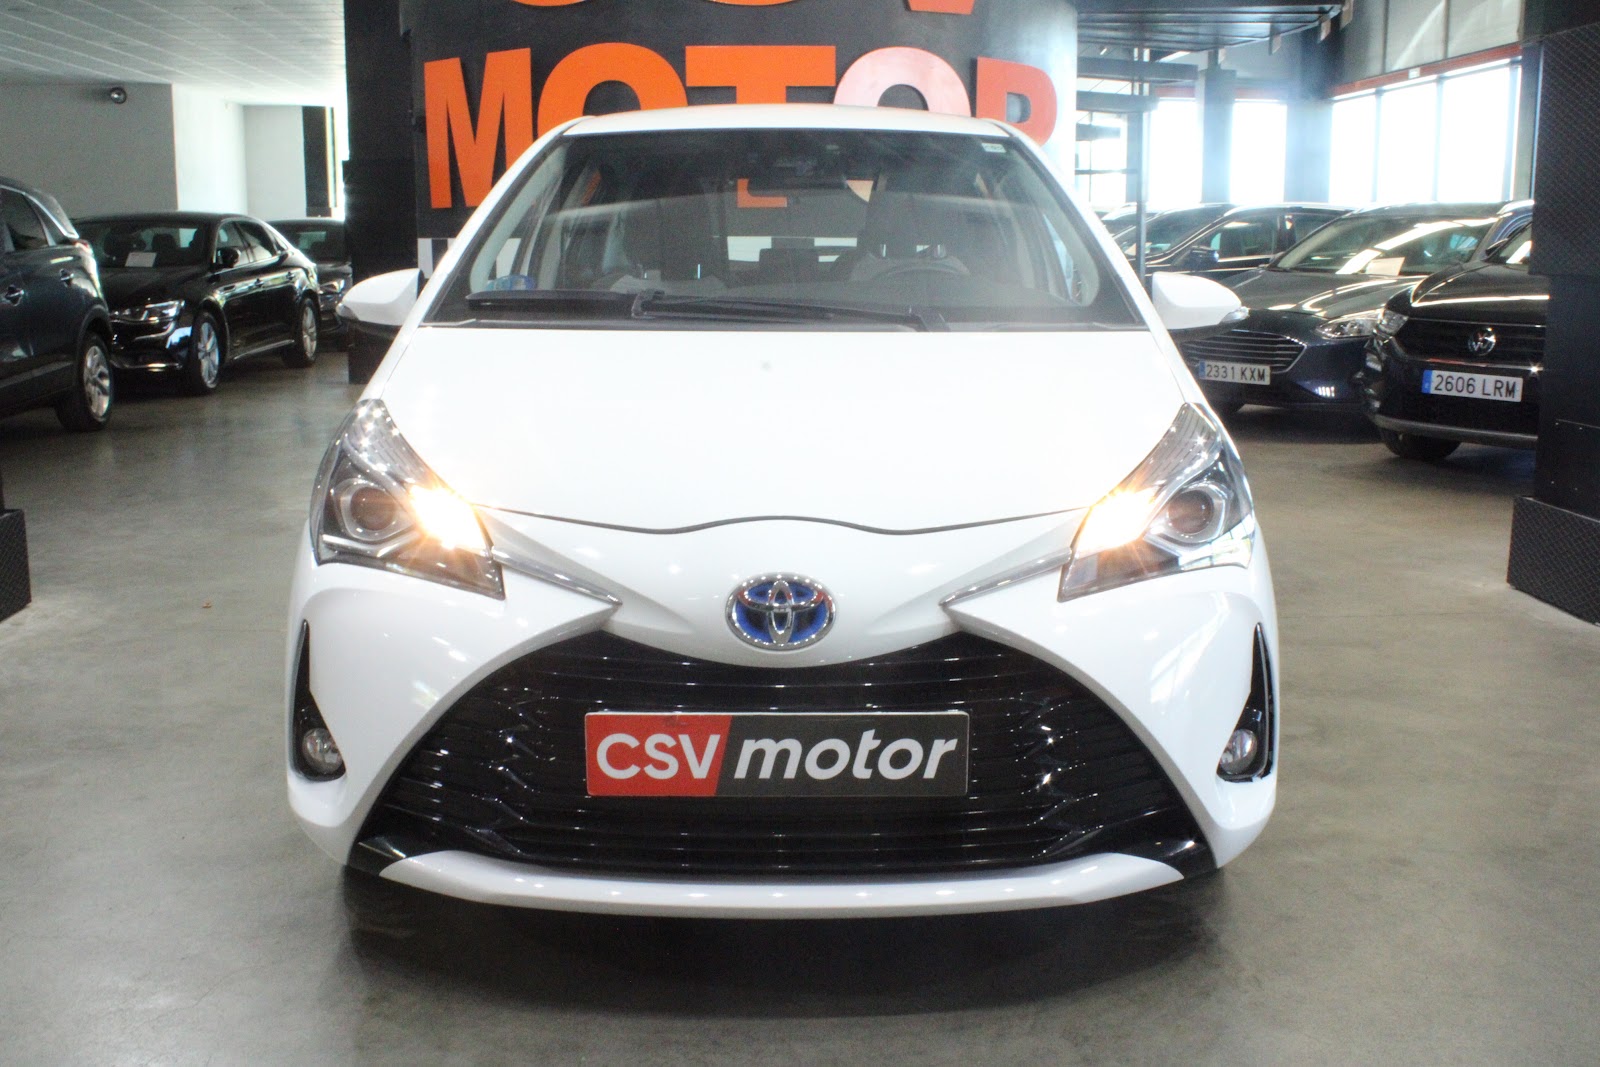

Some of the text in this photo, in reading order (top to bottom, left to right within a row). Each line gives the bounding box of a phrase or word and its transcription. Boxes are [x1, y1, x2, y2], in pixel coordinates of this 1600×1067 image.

[1206, 364, 1266, 382] 2331 KXM
[1434, 374, 1517, 399] 2606 LRM
[596, 728, 959, 781] CSV motor
